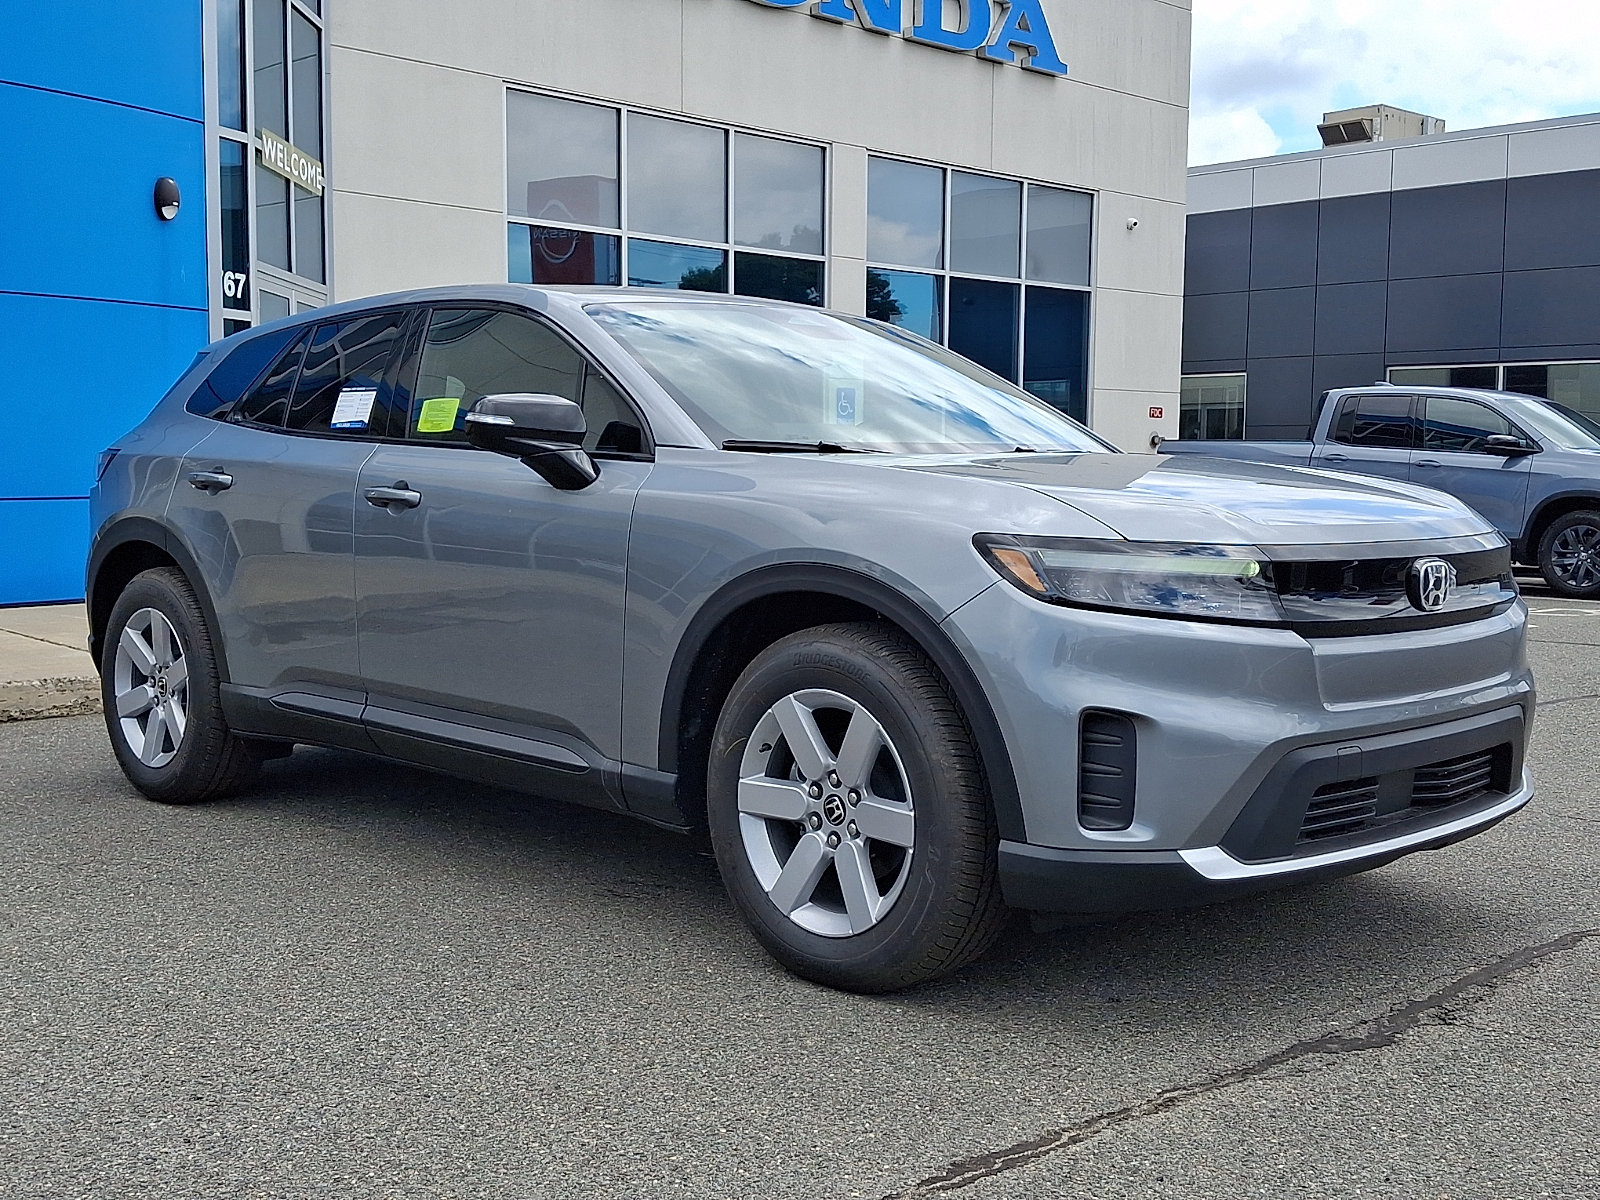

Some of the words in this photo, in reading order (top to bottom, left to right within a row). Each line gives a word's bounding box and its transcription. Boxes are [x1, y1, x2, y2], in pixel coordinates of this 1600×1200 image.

[262, 134, 322, 190] WELCOME
[1150, 408, 1162, 417] FDC
[793, 652, 872, 681] BRIDGESTONE
